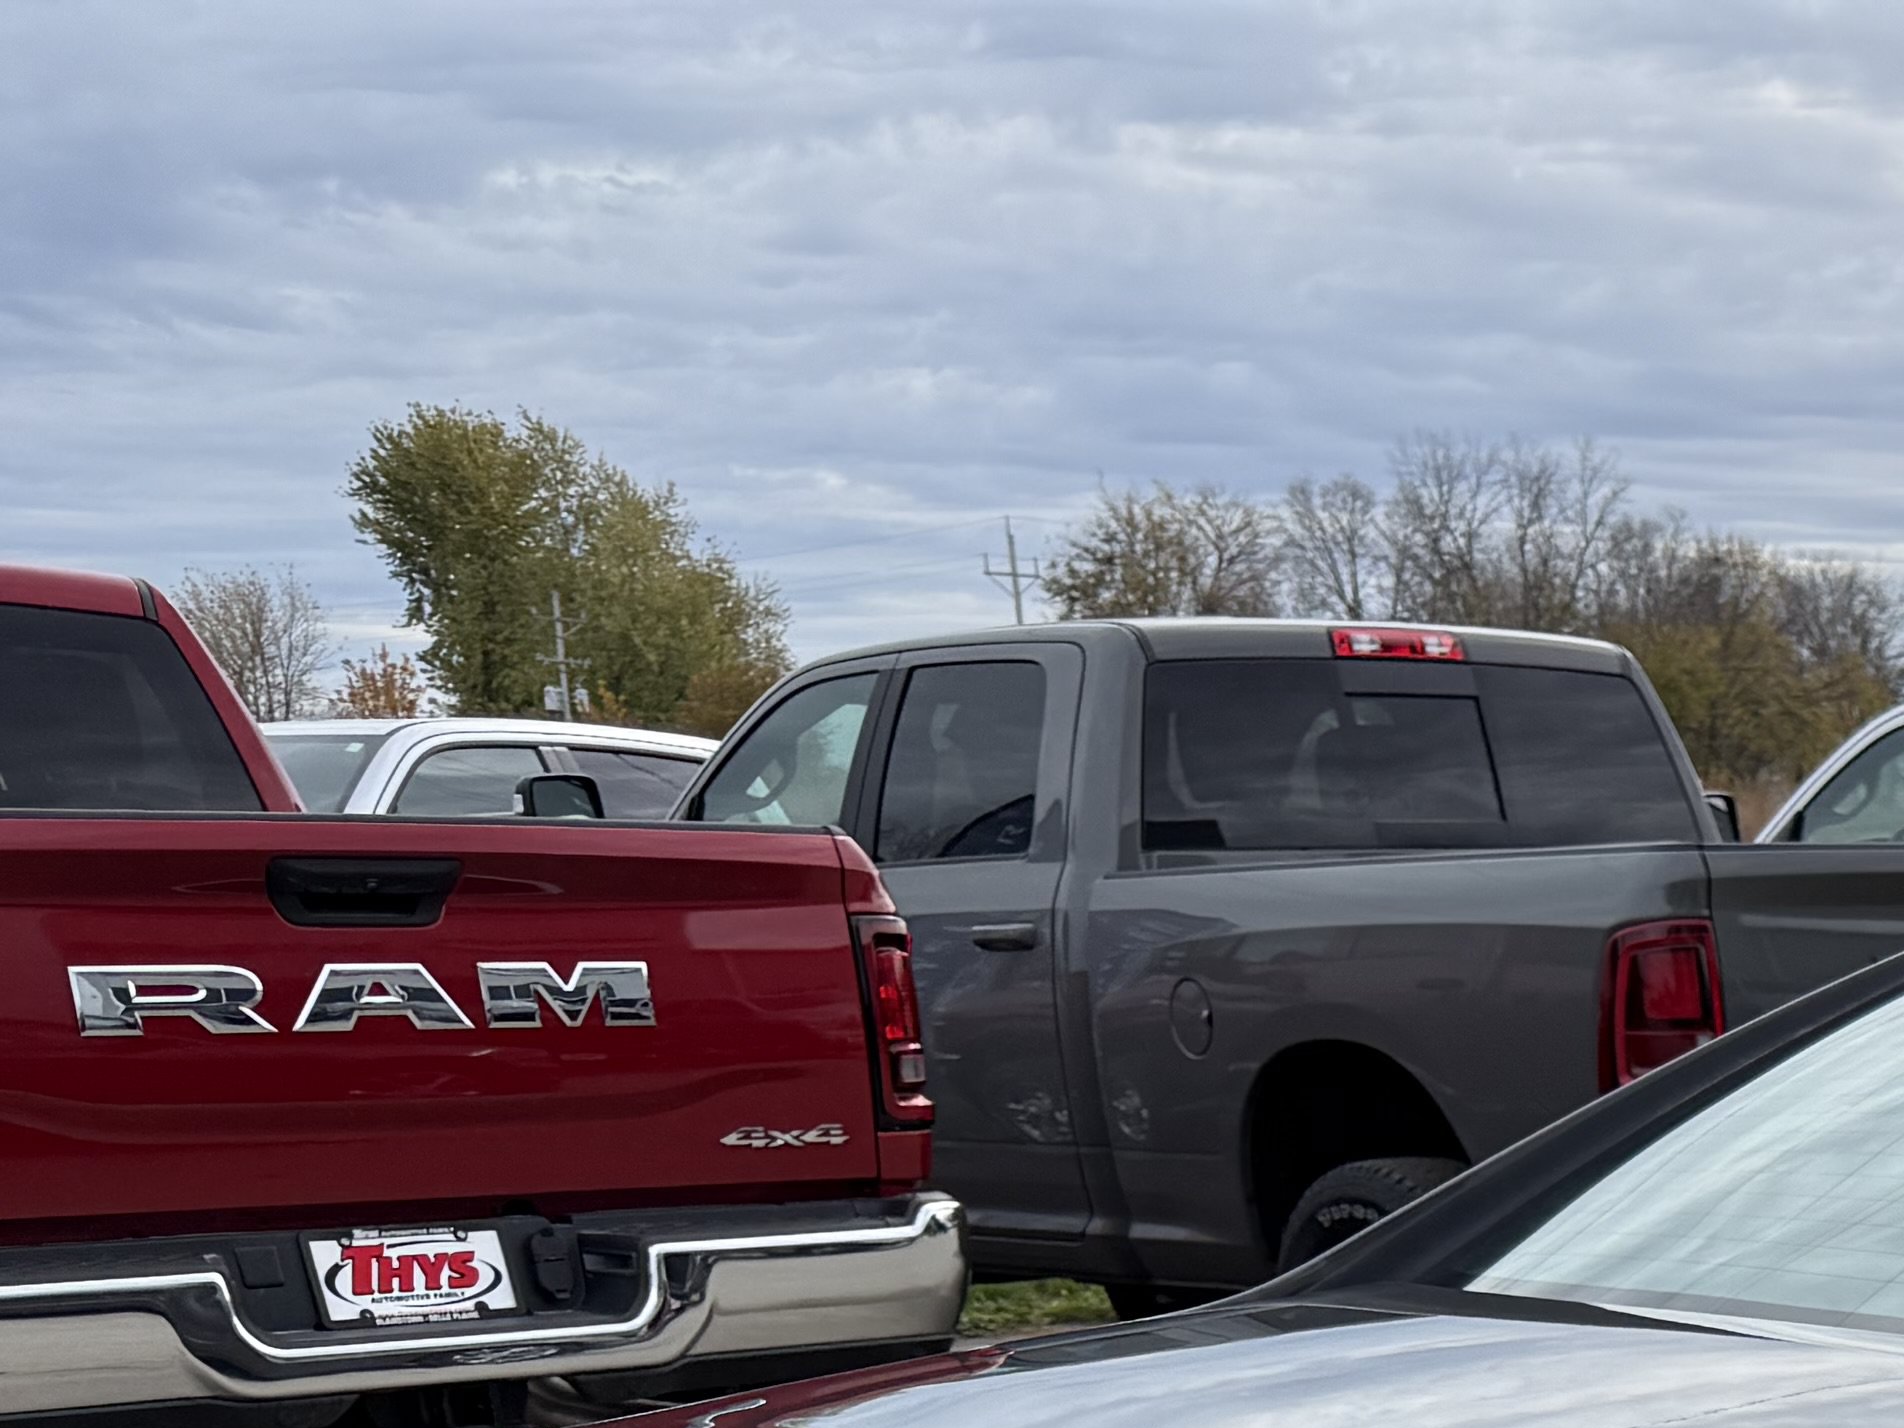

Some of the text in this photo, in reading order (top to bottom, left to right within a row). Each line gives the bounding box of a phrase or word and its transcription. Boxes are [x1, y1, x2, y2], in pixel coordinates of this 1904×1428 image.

[66, 962, 657, 1037] RAM
[719, 1123, 850, 1148] 4x4
[341, 1243, 480, 1296] THYS
